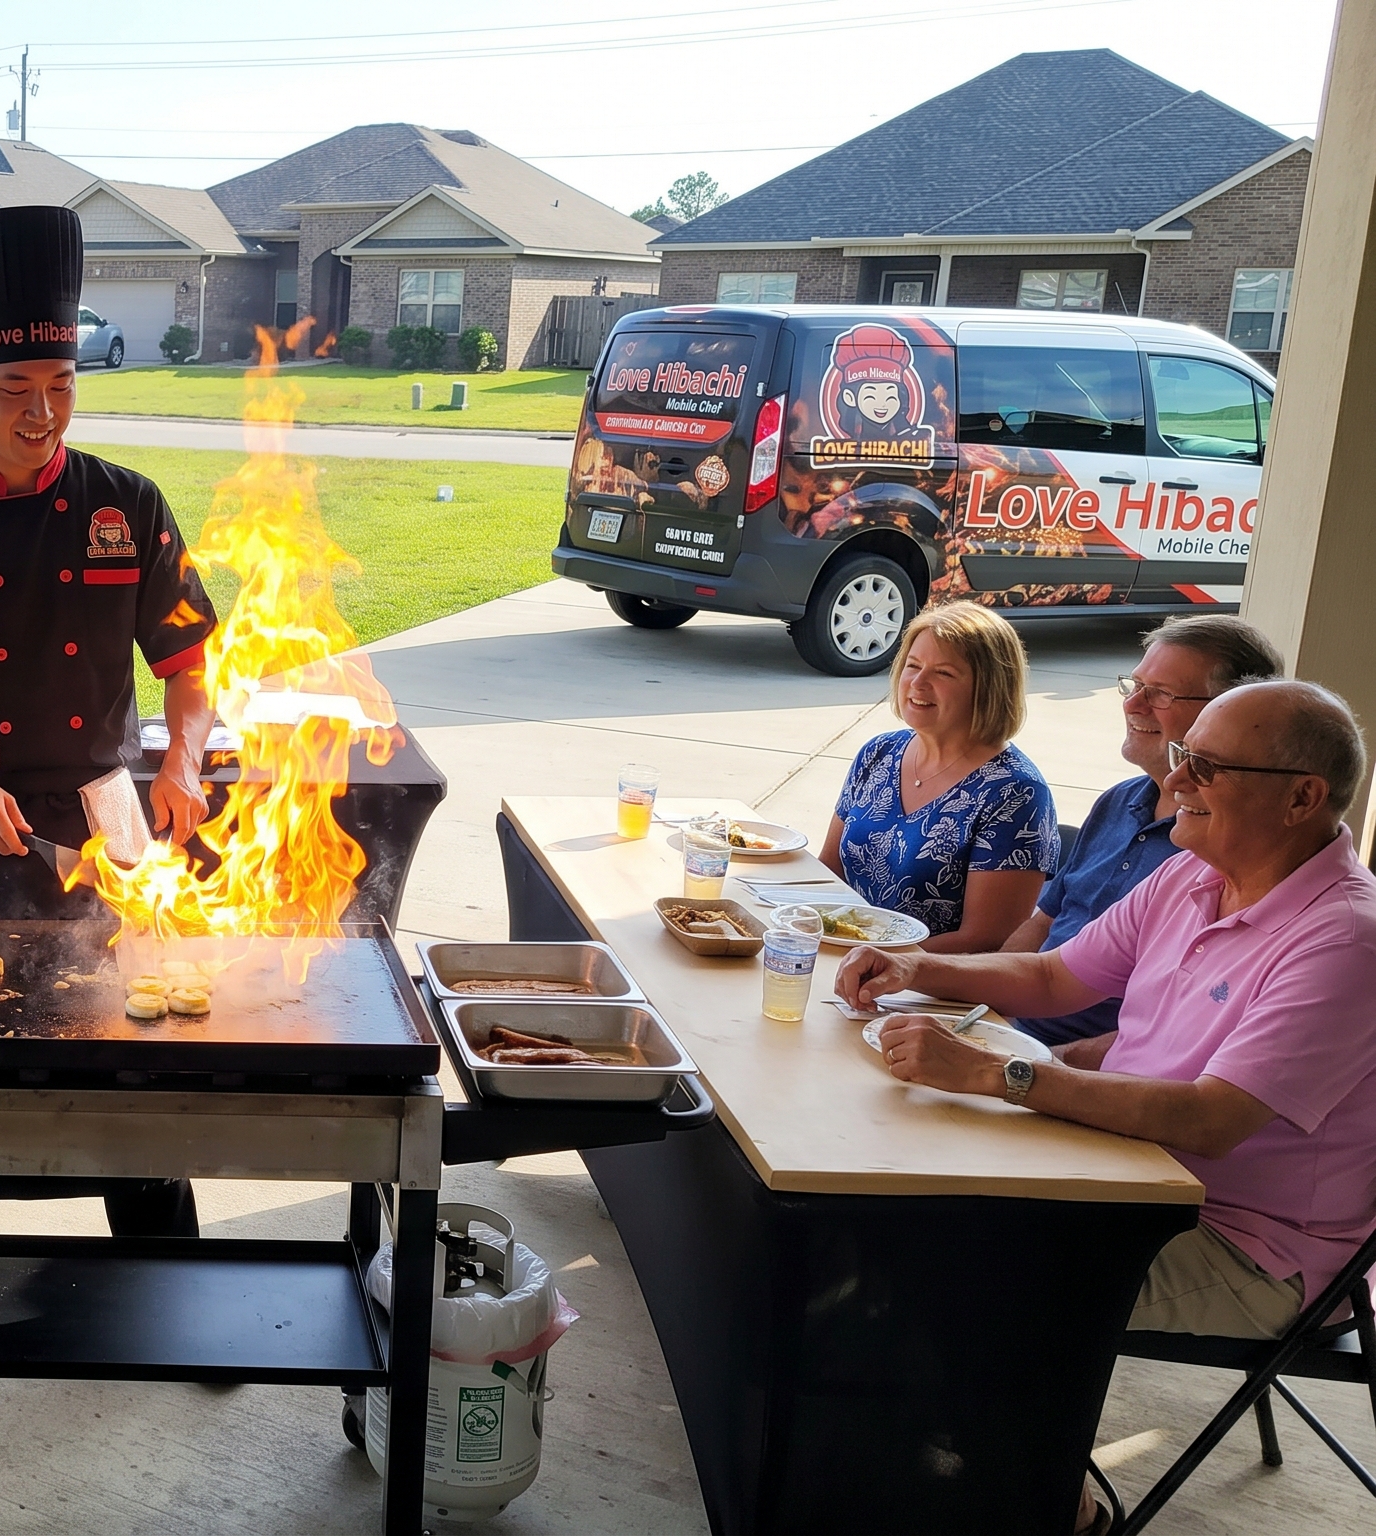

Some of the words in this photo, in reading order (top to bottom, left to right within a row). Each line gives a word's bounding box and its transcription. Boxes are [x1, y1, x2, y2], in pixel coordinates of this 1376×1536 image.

[607, 362, 650, 391] Love
[653, 362, 748, 398] Hibachi
[815, 441, 858, 462] LOVE
[964, 470, 1101, 530] Love
[1157, 537, 1214, 554] Mobile
